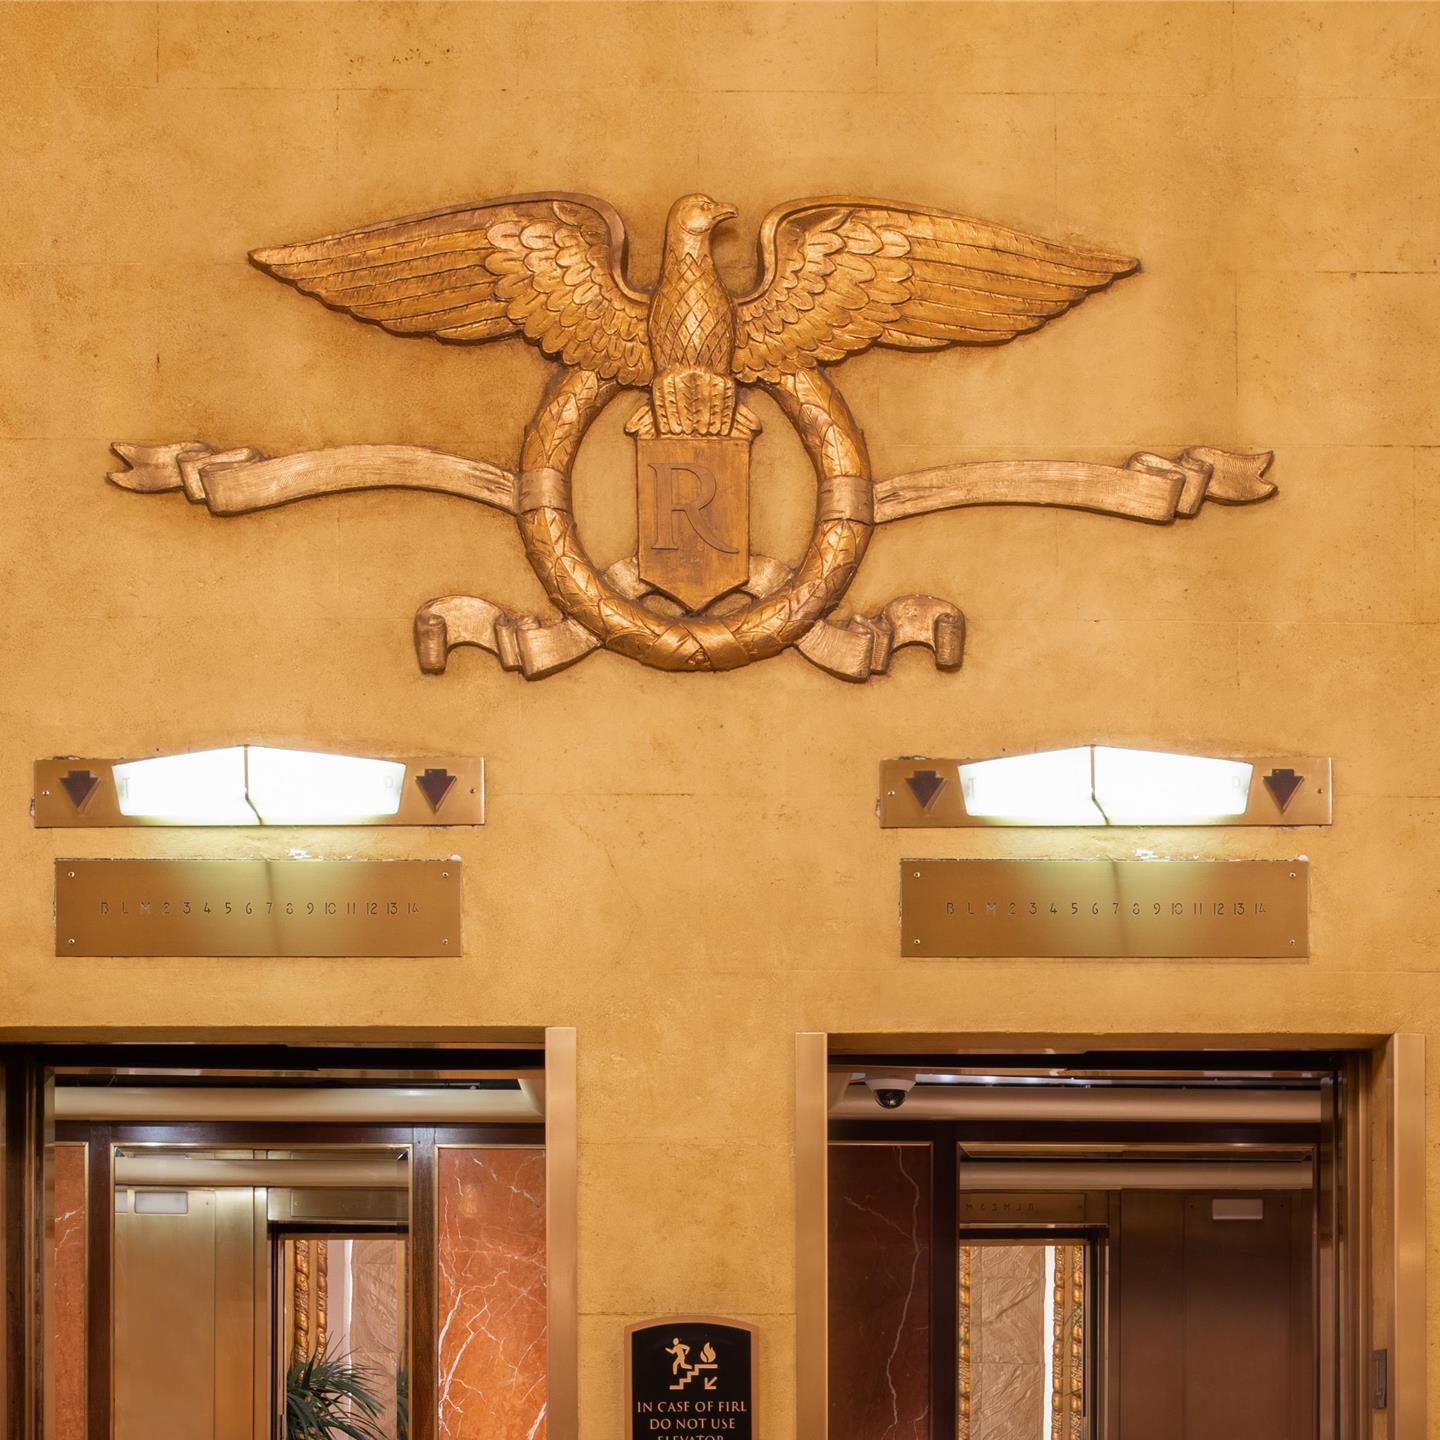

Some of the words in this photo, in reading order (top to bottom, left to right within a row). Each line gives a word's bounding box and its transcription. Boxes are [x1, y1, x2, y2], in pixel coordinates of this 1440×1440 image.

[647, 462, 740, 555] R
[101, 902, 109, 914] B
[122, 902, 128, 914] L
[164, 902, 170, 914] 2
[184, 902, 191, 914] 3
[204, 902, 211, 914] 4
[225, 902, 232, 914] 5
[246, 902, 252, 914] 6
[266, 902, 272, 914] 7
[286, 902, 294, 914] 8
[307, 902, 314, 914] 9
[325, 902, 336, 914] 10
[347, 902, 356, 914] 11
[366, 902, 377, 914] 12
[386, 902, 398, 914] 13
[407, 902, 419, 914] 14
[946, 902, 954, 914] B
[968, 902, 974, 914] L
[1009, 902, 1016, 914] 2
[1029, 902, 1037, 914] 3
[1050, 902, 1057, 914] 4
[1071, 902, 1078, 914] 5
[1091, 902, 1099, 914] 6
[1112, 902, 1119, 914] 7
[1133, 902, 1140, 914] 8
[1153, 902, 1160, 914] 9
[1171, 902, 1183, 914] 10
[1193, 902, 1203, 914] 11
[1213, 902, 1224, 914] 12
[1233, 902, 1244, 914] 13
[1254, 902, 1265, 914] 14
[637, 1401, 653, 1413] IN
[657, 1401, 690, 1413] CASE
[695, 1401, 714, 1413] OF
[718, 1401, 747, 1413] FIRE
[649, 1418, 671, 1430] DO
[676, 1418, 707, 1430] NOT
[711, 1418, 736, 1430] USE
